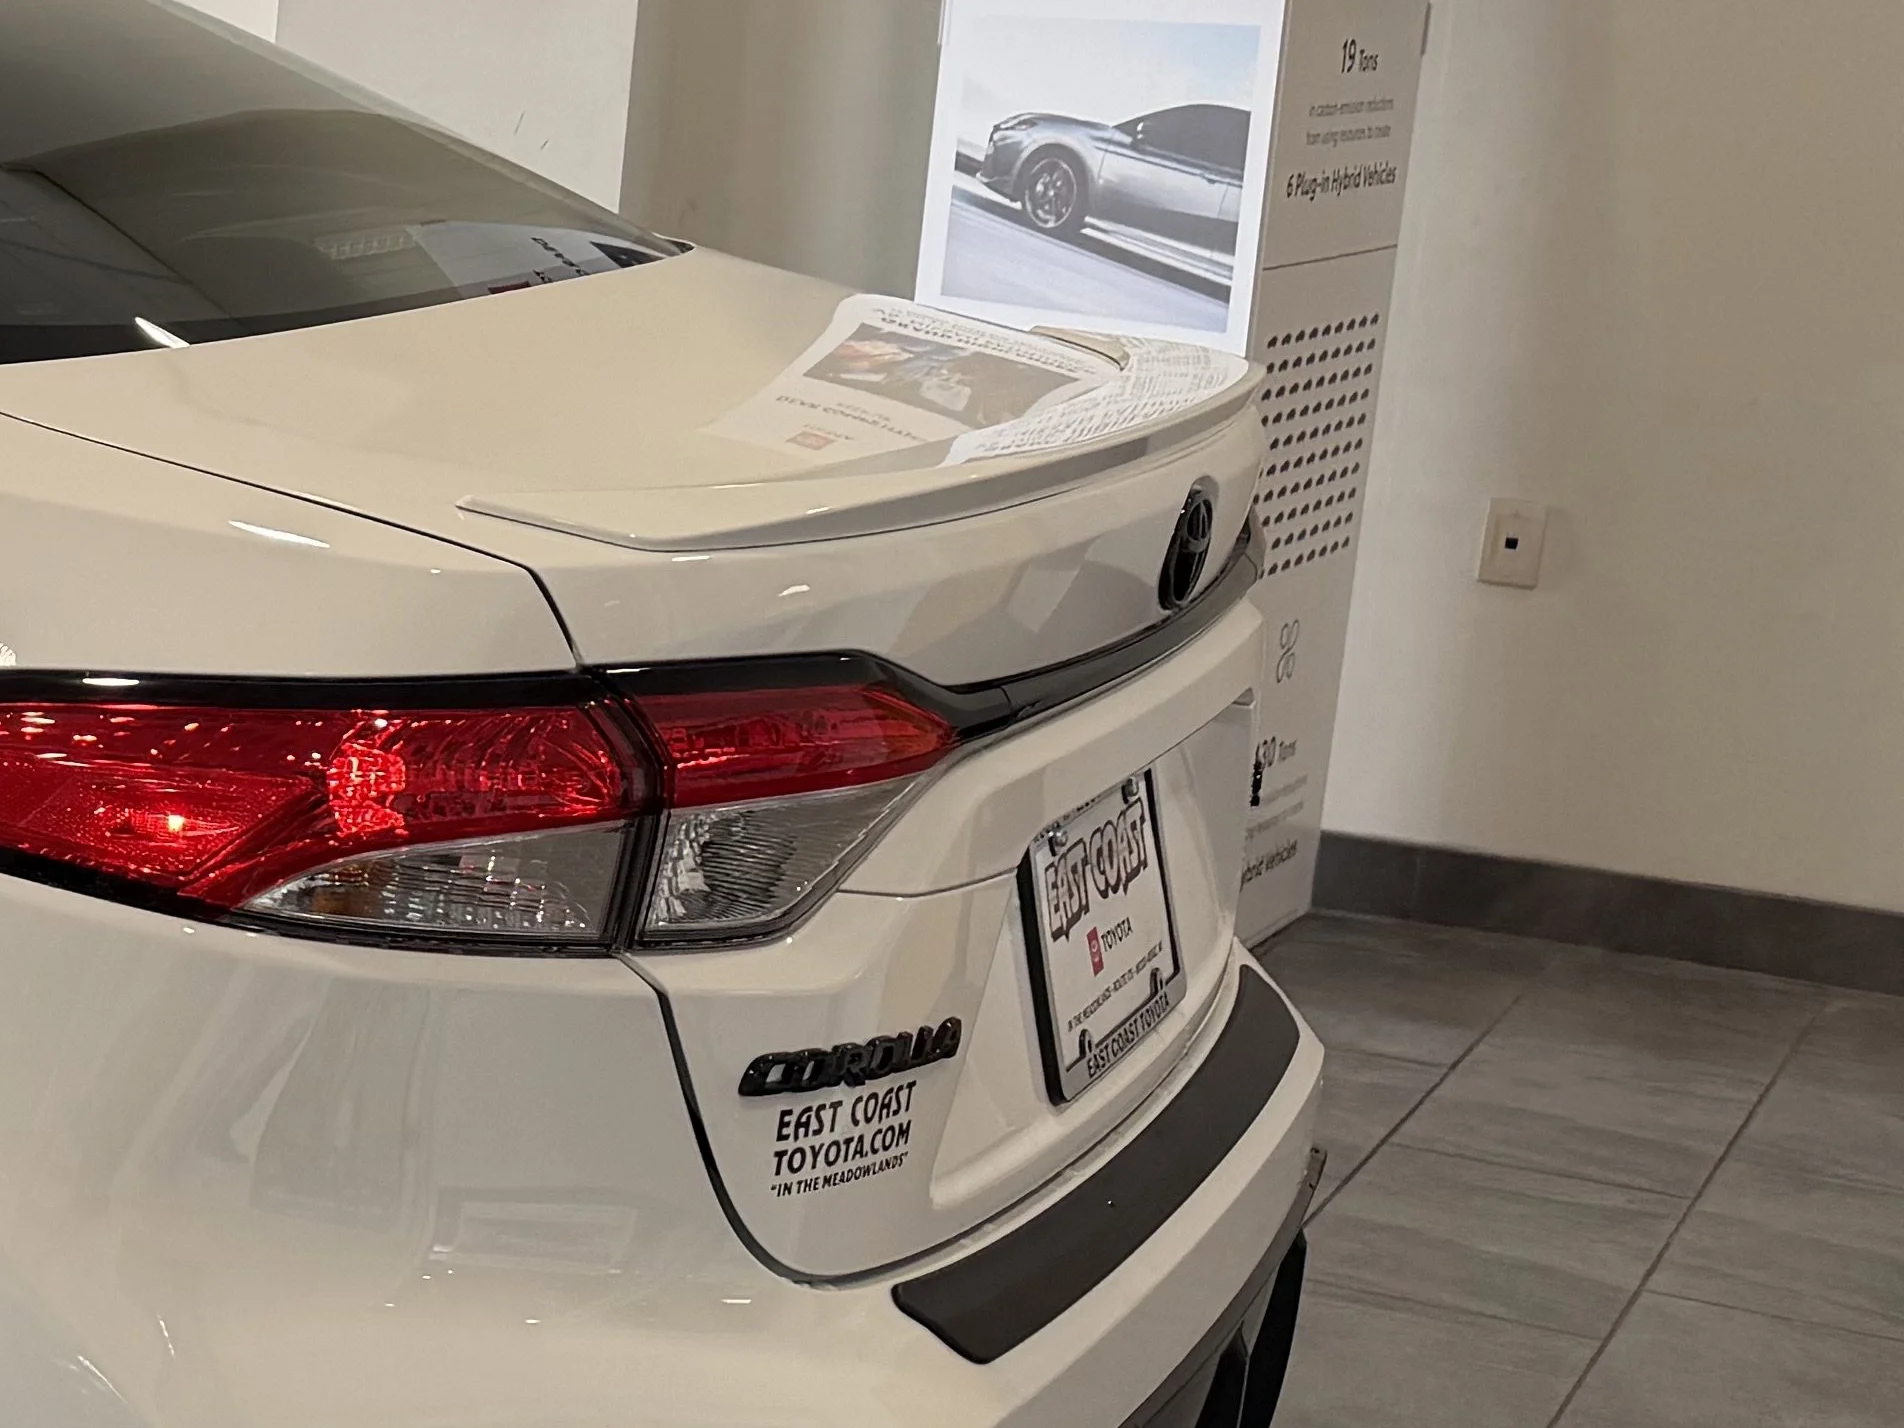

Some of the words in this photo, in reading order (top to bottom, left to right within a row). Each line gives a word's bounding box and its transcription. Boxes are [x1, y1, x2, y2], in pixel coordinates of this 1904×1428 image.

[1341, 38, 1357, 74] 19
[1286, 173, 1294, 198] 6
[1294, 169, 1330, 202] Plug-in
[1331, 164, 1362, 197] Hybrid
[1363, 160, 1397, 188] Vehicles
[1045, 837, 1091, 942] EAST
[1089, 797, 1148, 900] COAST
[1101, 917, 1133, 952] TOYOTA
[738, 1016, 962, 1097] COROLLA
[1087, 1044, 1112, 1078] EAST
[1111, 1018, 1142, 1058] COAST
[1140, 991, 1170, 1031] TOYOTA
[776, 1100, 843, 1142] EAST
[851, 1080, 917, 1126] COAST
[774, 1120, 911, 1176] TOYOTA.COM
[796, 1177, 819, 1194] THE
